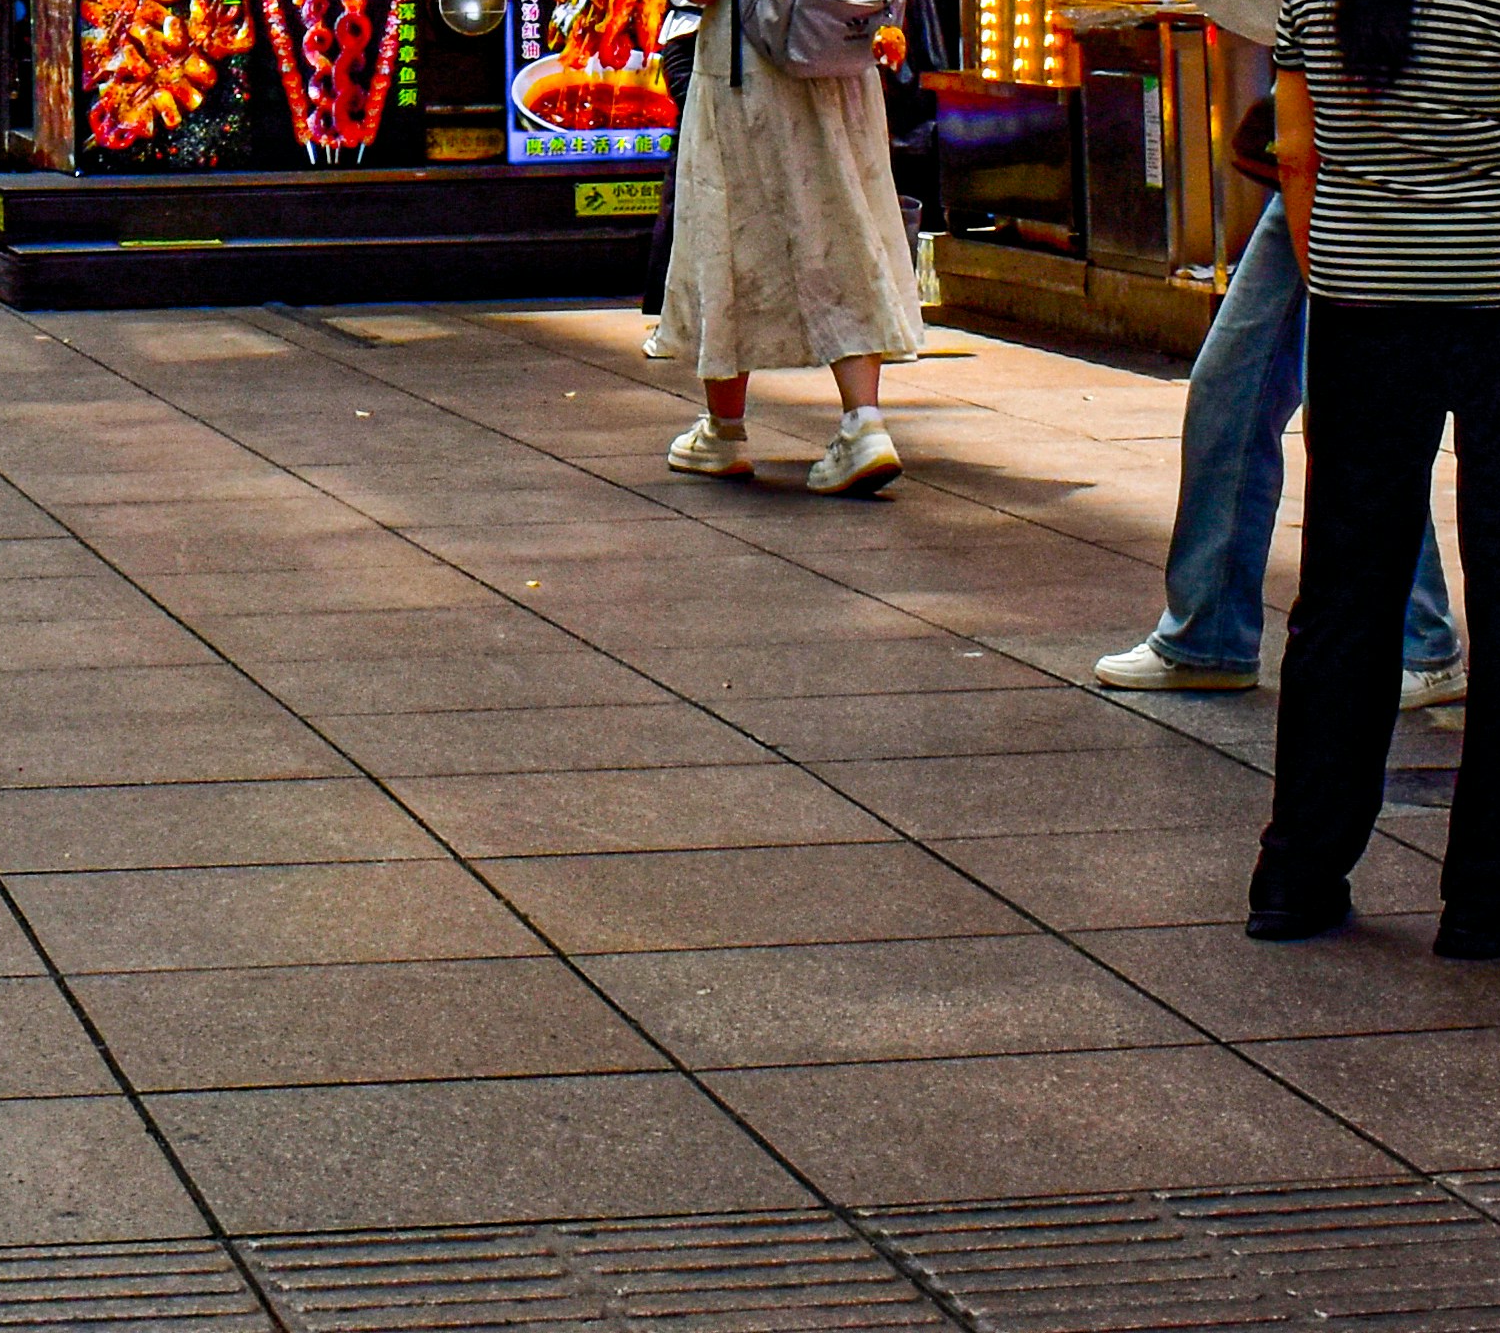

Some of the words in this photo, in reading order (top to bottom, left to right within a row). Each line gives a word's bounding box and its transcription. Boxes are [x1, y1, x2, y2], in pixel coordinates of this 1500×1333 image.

[397, 2, 419, 107] 深海章鱼须
